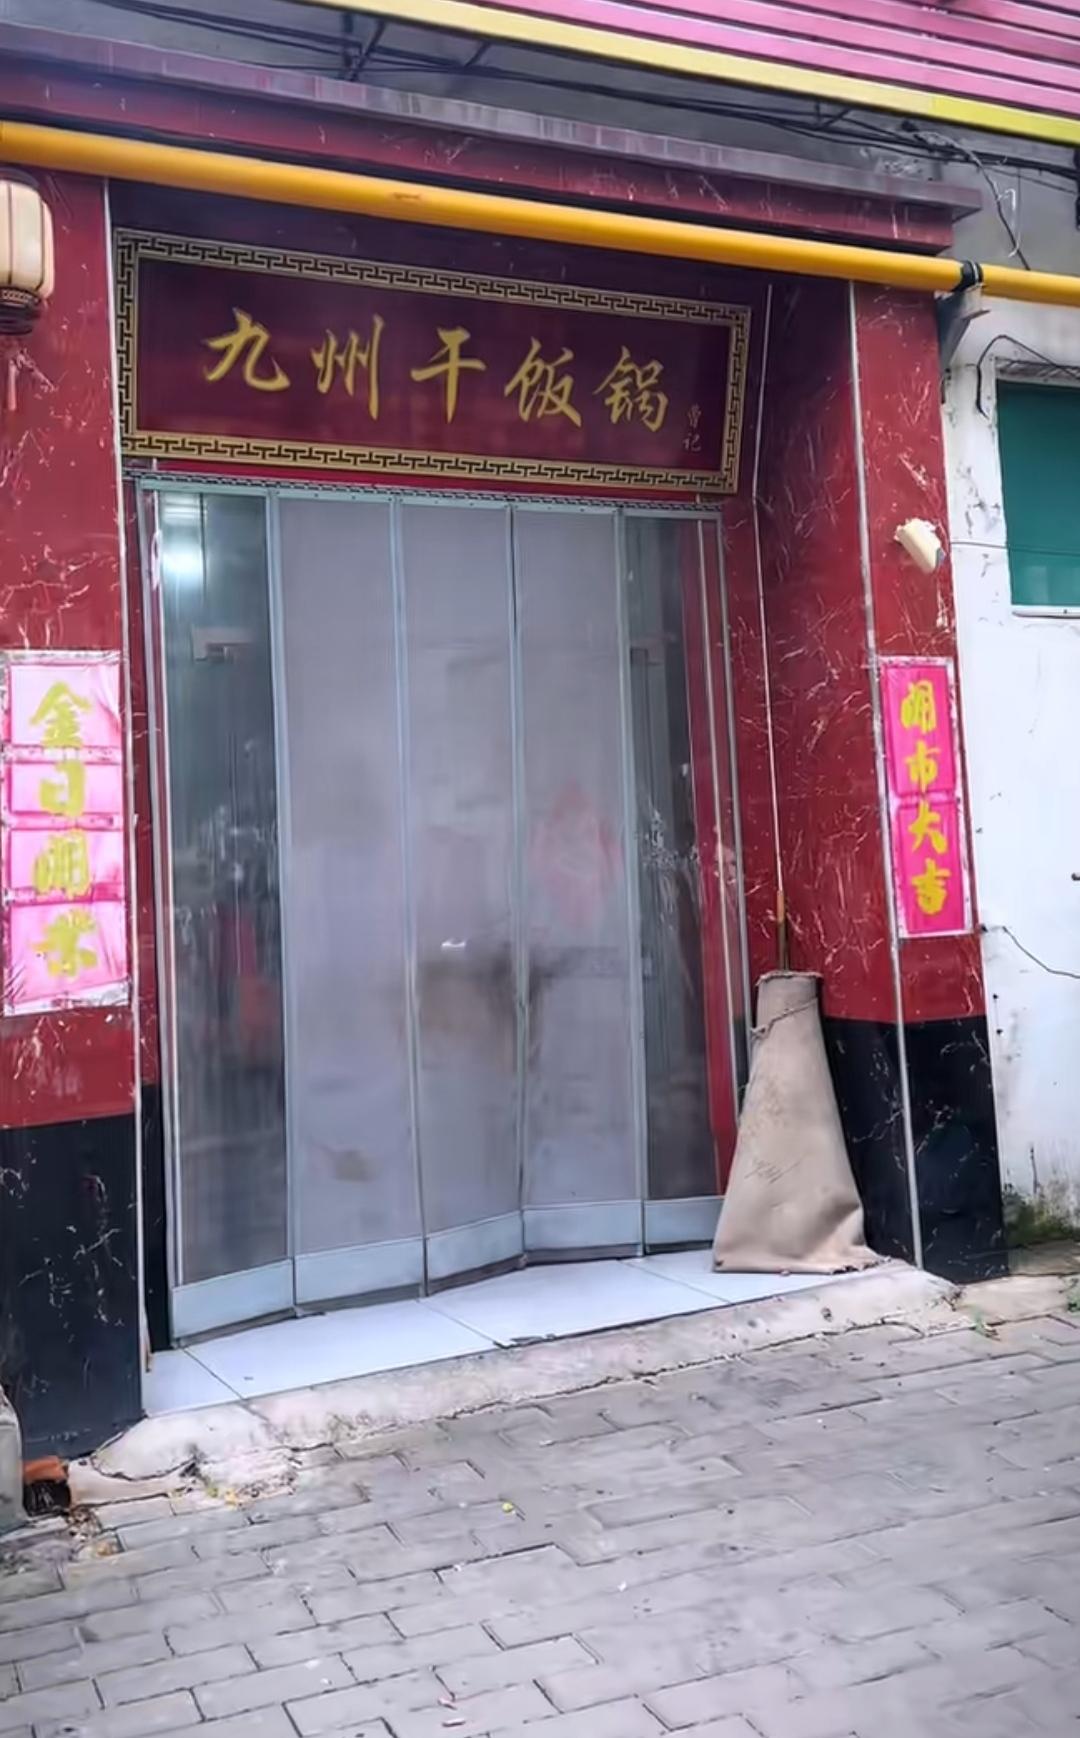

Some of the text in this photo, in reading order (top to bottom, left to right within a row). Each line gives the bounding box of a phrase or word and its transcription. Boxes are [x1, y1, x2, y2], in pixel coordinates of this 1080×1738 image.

[202, 306, 669, 432] 九州干饭锅
